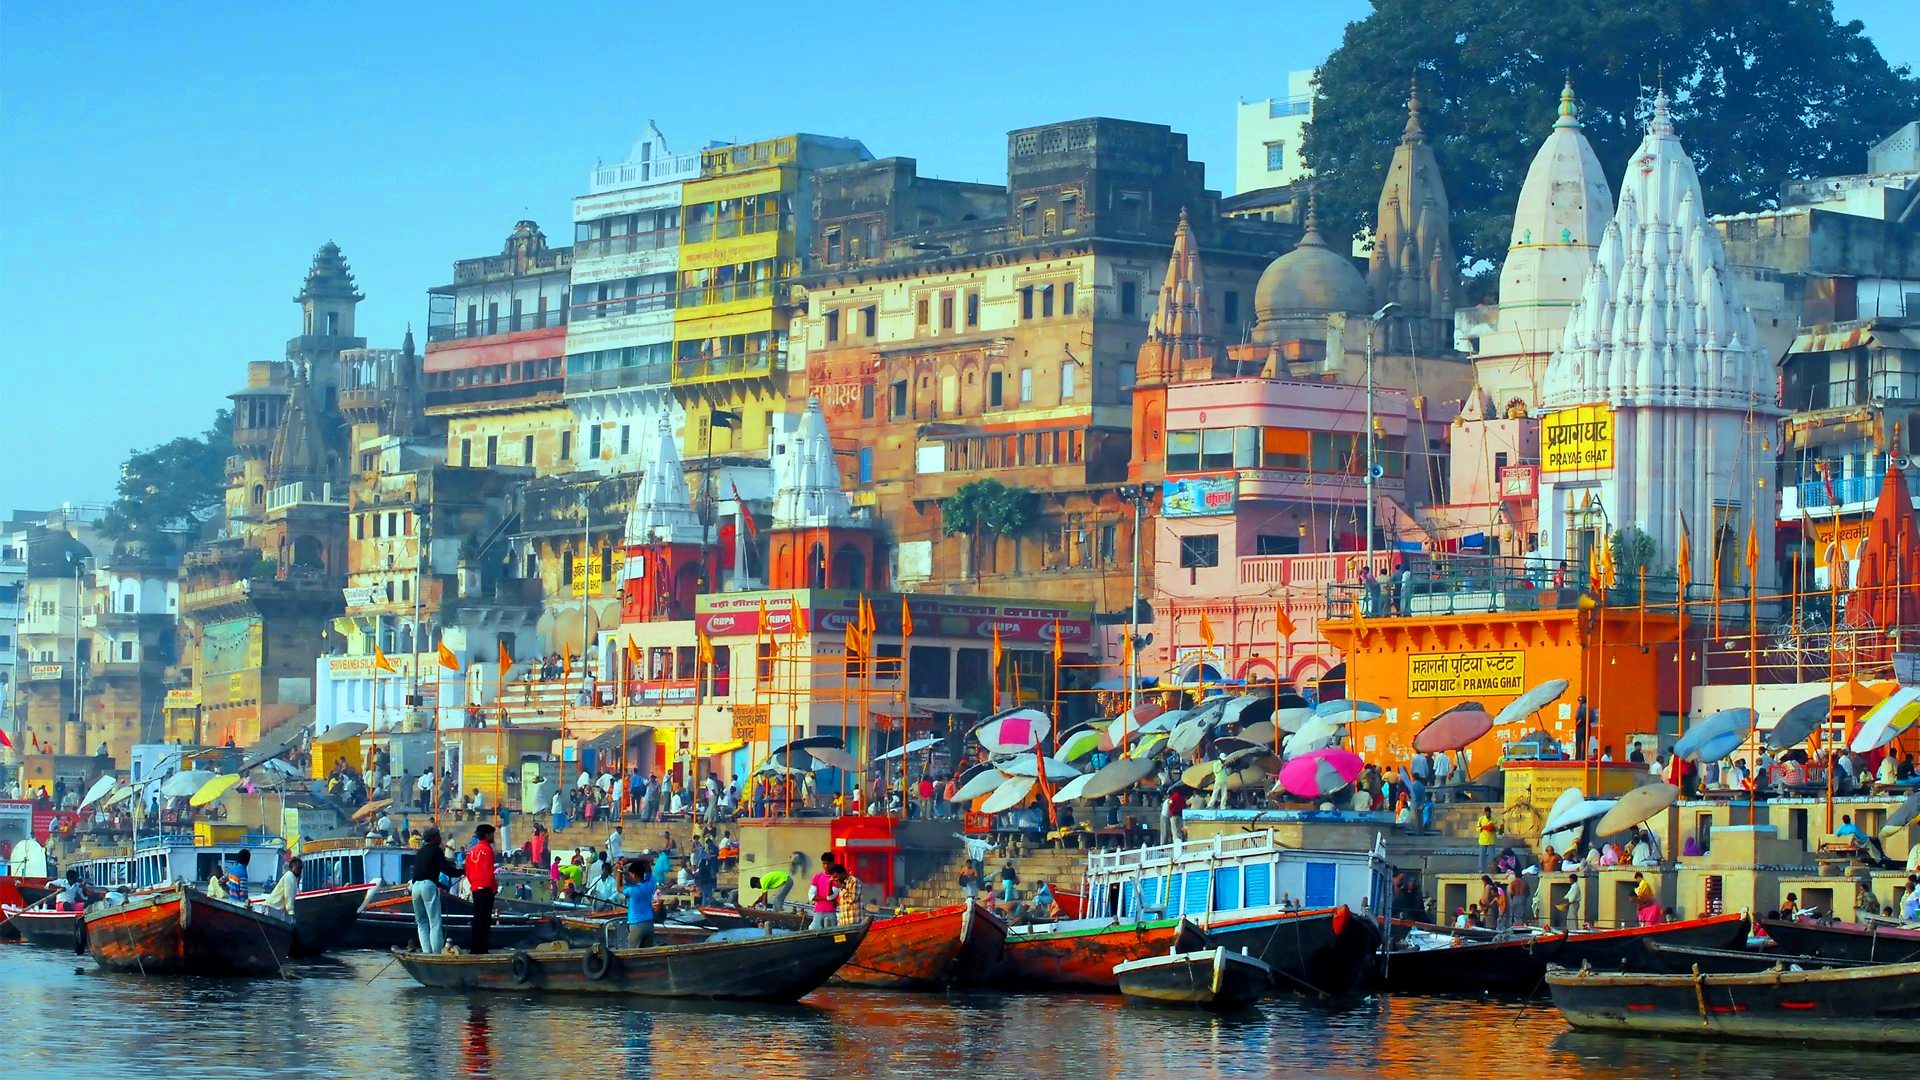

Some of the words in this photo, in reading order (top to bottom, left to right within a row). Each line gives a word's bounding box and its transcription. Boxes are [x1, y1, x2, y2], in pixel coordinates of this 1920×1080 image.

[1547, 423, 1584, 449] प्रयाग
[1585, 421, 1607, 441] घाट
[1550, 451, 1582, 466] PRAYAG
[1585, 449, 1607, 462] GHAT
[713, 617, 735, 625] RUPA
[769, 615, 791, 624] RUPA
[831, 615, 857, 624] RUP
[1463, 678, 1498, 690] PRAYAG
[1500, 677, 1522, 688] GHAT
